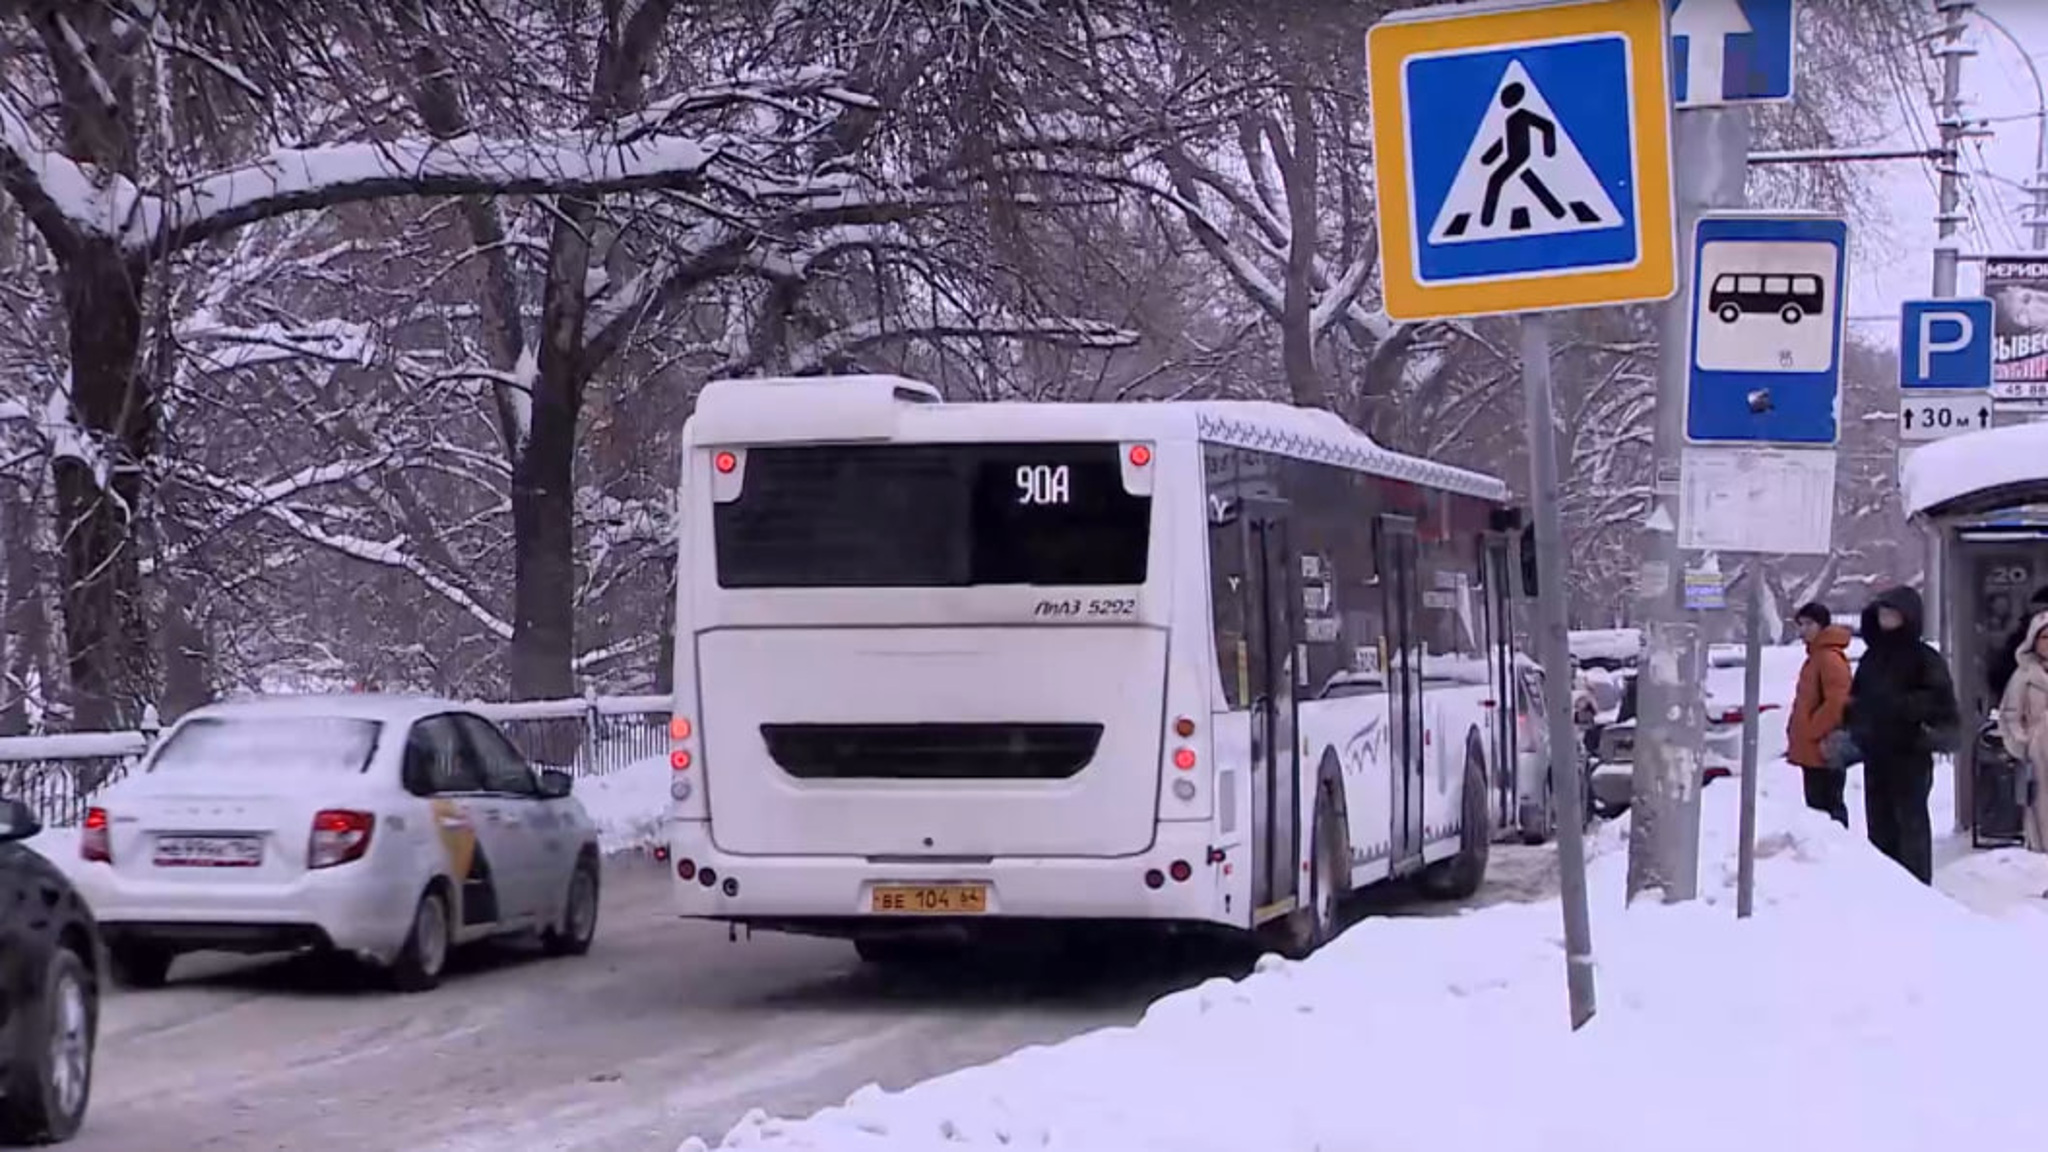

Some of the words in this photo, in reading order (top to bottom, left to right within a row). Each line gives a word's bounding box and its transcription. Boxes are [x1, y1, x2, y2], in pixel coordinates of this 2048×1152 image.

[1918, 311, 1973, 379] P
[1922, 408, 1952, 428] 30
[1015, 465, 1069, 504] 90А
[1087, 600, 1136, 614] 5292
[915, 889, 949, 909] 104
